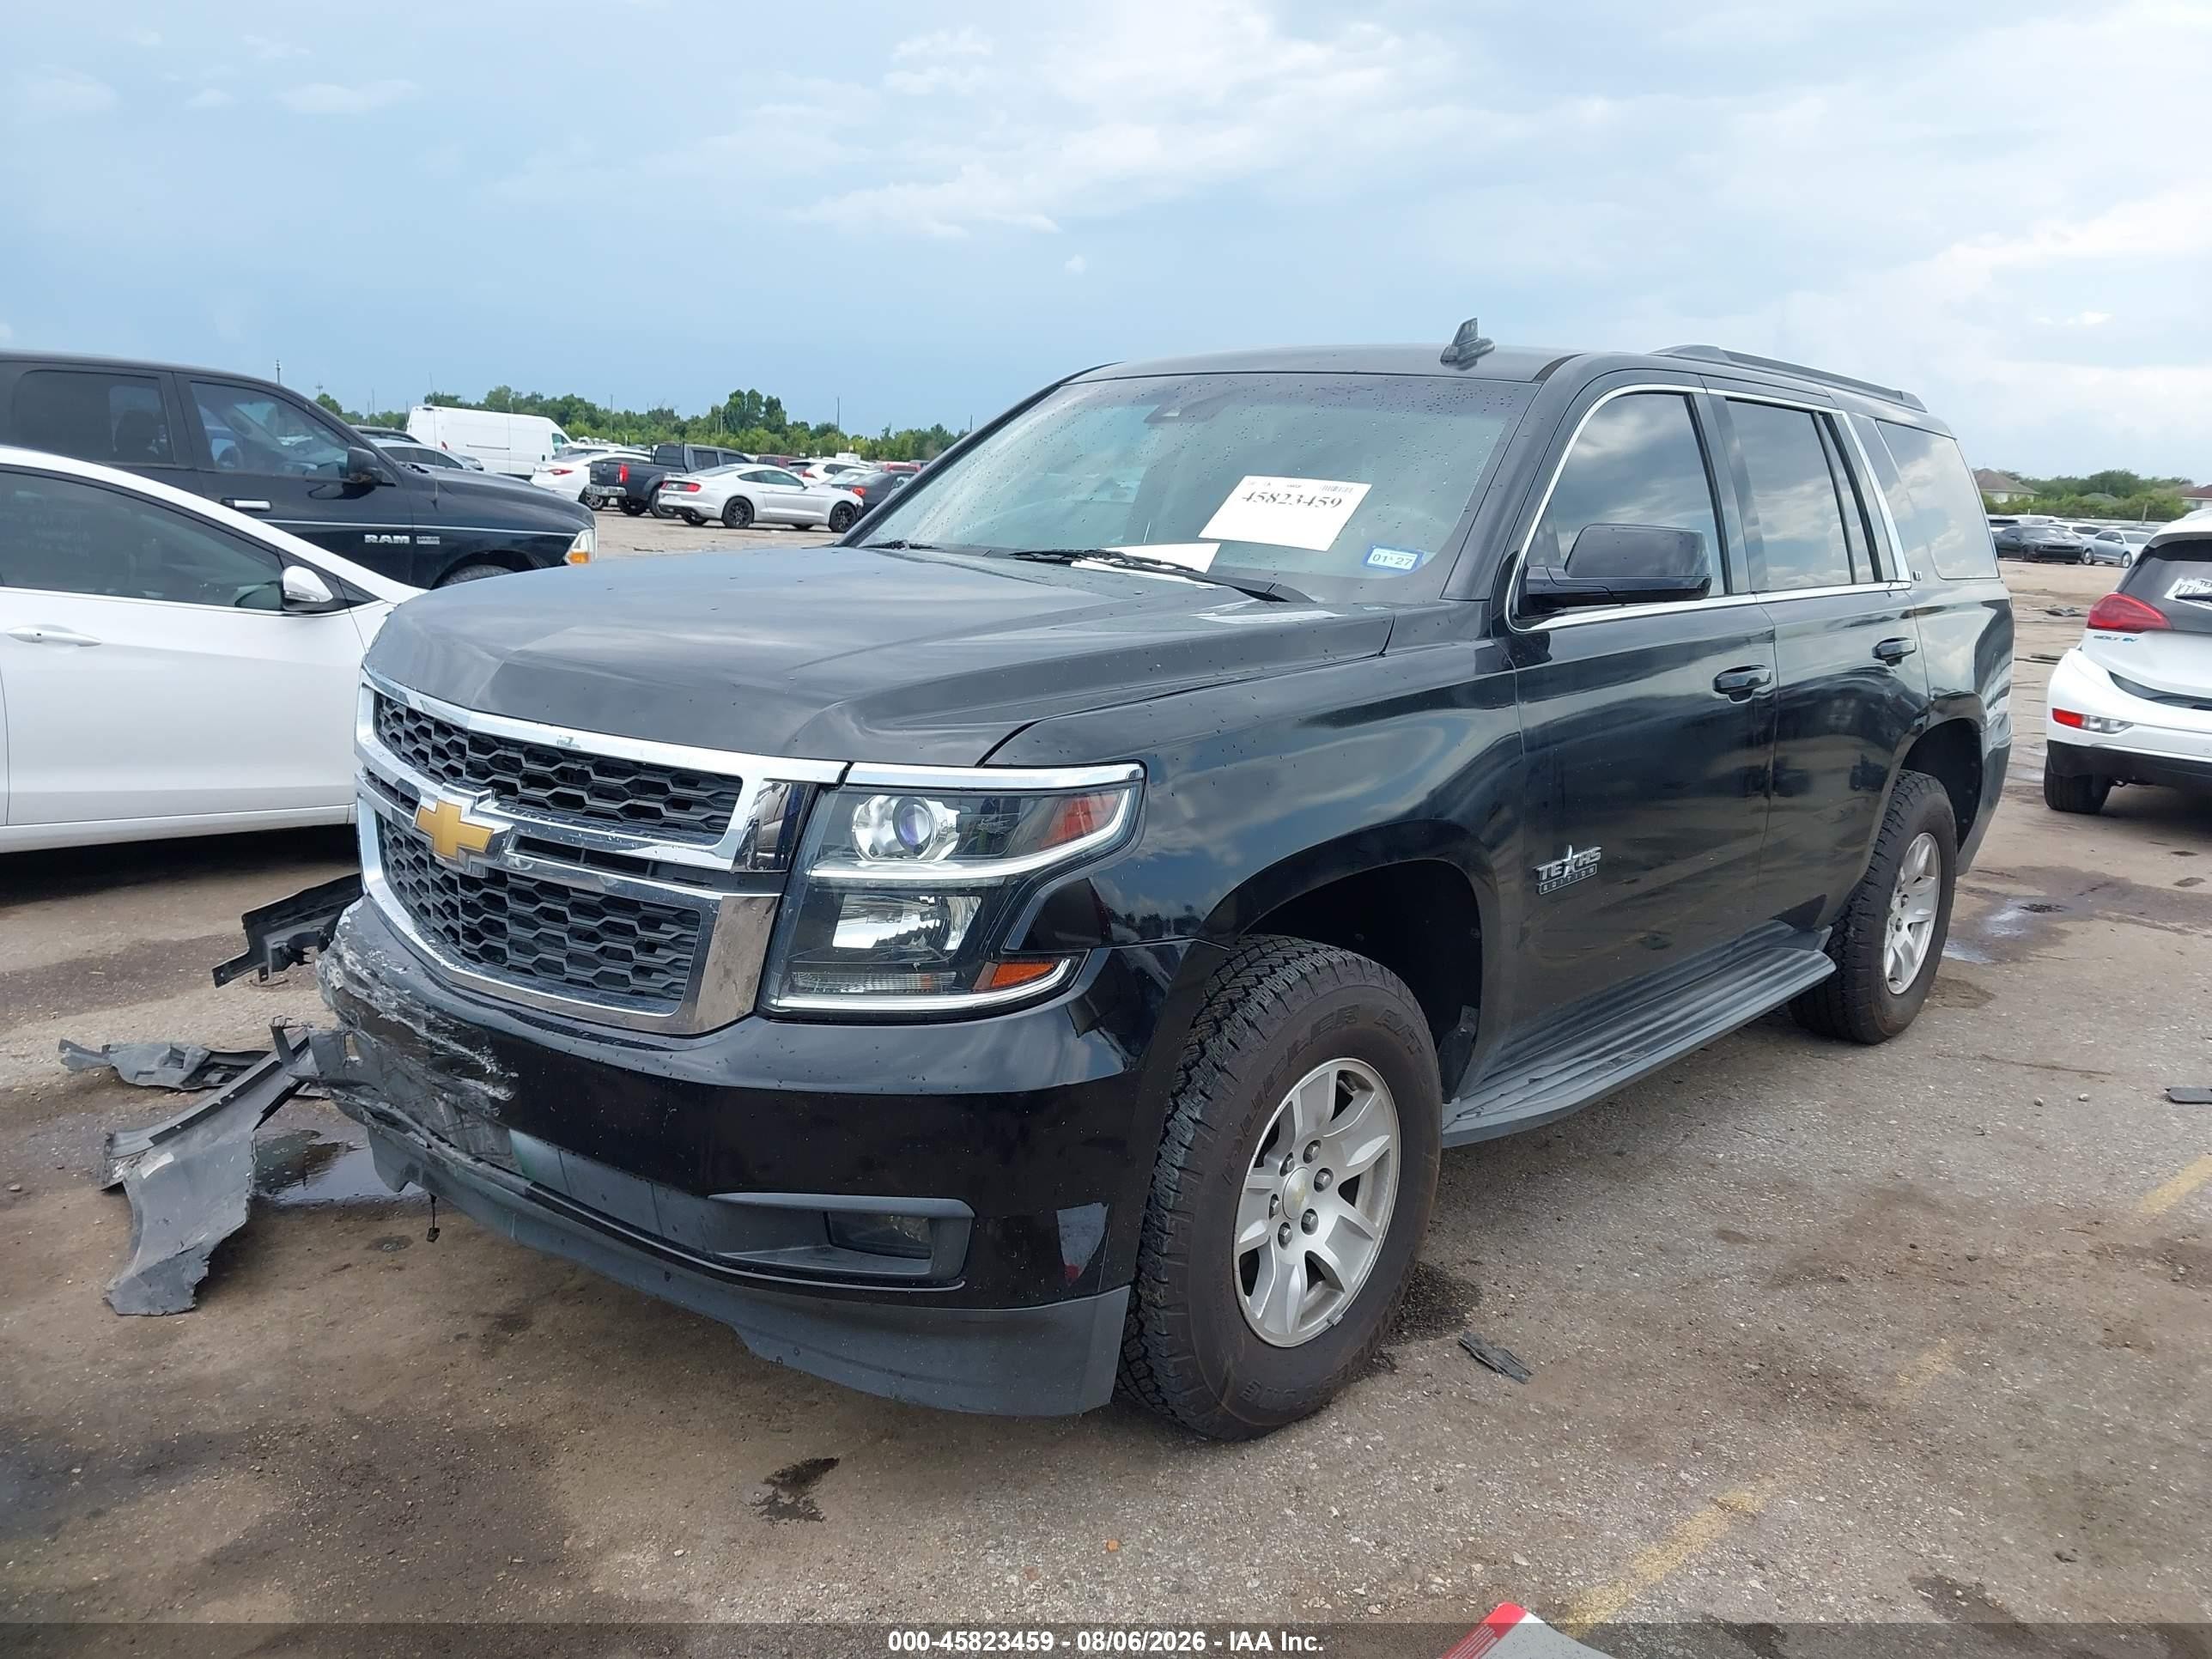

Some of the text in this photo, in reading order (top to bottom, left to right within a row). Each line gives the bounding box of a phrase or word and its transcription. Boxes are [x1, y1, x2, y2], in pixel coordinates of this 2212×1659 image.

[1242, 491, 1343, 508] 45823459
[364, 533, 410, 544] RAM
[1534, 845, 1602, 881] TEXAS
